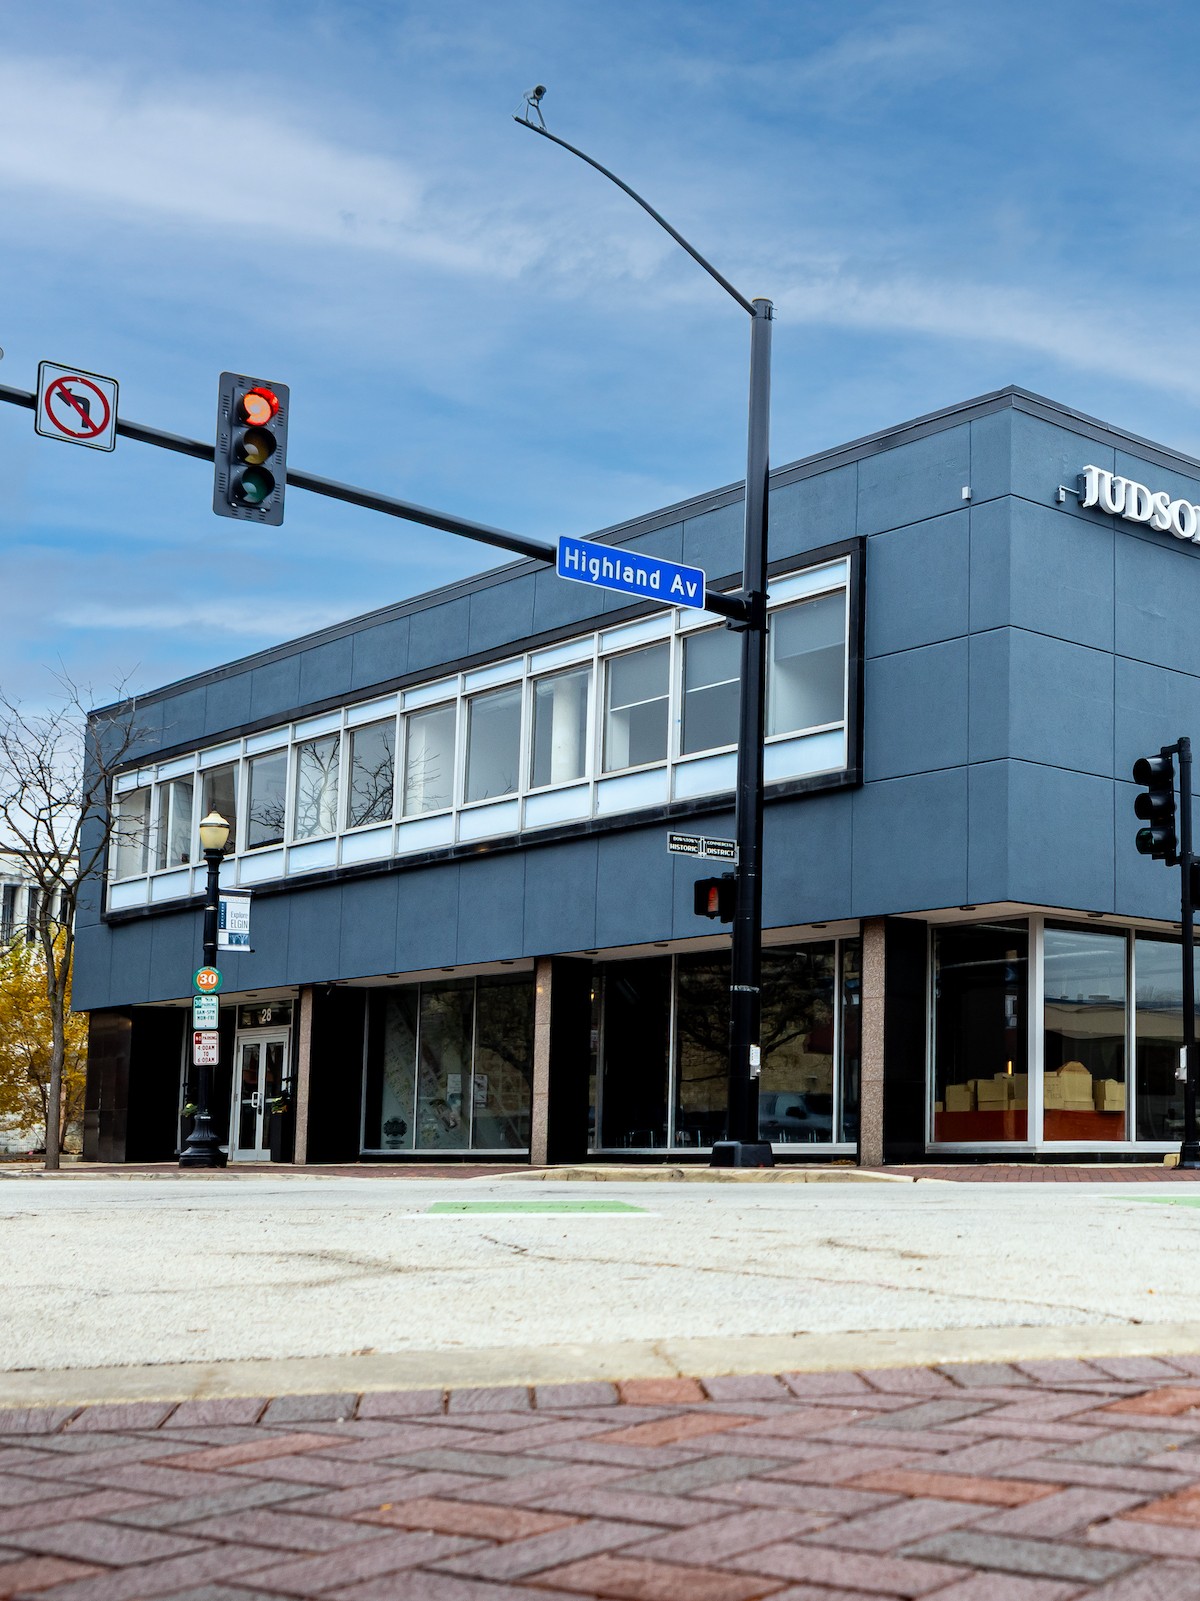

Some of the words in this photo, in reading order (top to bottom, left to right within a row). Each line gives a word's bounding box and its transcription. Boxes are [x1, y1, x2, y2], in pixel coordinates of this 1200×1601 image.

[564, 546, 660, 581] Highland
[670, 573, 698, 598] Av
[670, 844, 699, 852] HISTORIC
[707, 848, 735, 856] DISTRICT
[230, 911, 248, 919] Explore
[230, 919, 248, 929] ELGIN
[199, 973, 217, 985] 30
[262, 1008, 272, 1021] 28
